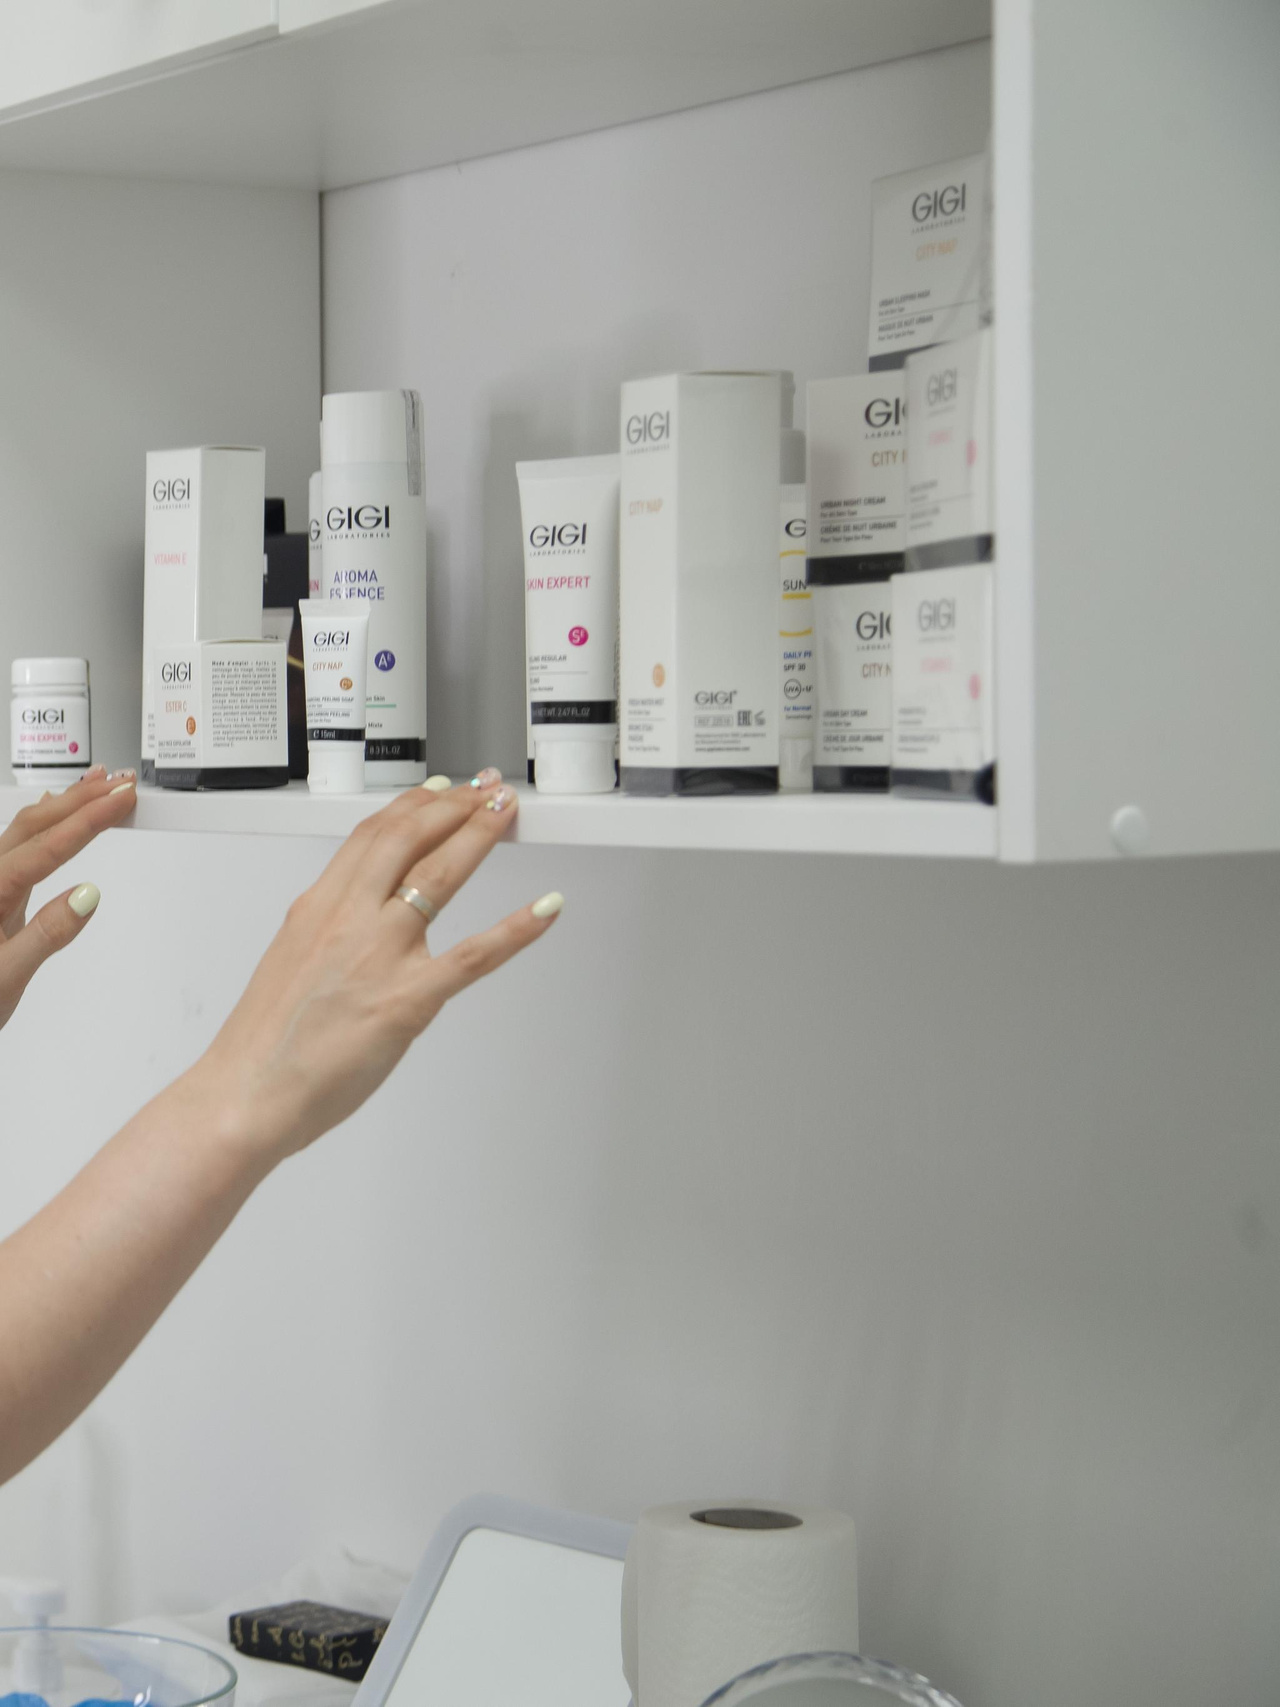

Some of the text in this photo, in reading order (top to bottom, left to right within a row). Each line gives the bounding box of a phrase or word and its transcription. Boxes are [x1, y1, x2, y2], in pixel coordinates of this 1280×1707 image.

[911, 182, 966, 223] GIGI
[927, 368, 958, 406] GIGI
[864, 397, 906, 428] GI
[626, 410, 670, 444] GIGI
[871, 450, 898, 468] CITY
[152, 478, 190, 502] GIGI
[326, 504, 390, 531] GIGI
[326, 532, 390, 540] LABORATORIES
[530, 522, 587, 548] GIGI
[154, 552, 180, 566] VITAMIN
[334, 569, 378, 584] AROMA
[526, 576, 590, 591] SKIN EXPERT
[783, 579, 807, 592] SUN
[919, 598, 956, 632] GIGI
[314, 630, 350, 646] GIGI
[784, 651, 802, 660] DAILY
[162, 662, 192, 684] GIGI
[312, 662, 344, 672] CITY NAP
[784, 663, 796, 672] SPF
[862, 663, 883, 678] CITY
[166, 700, 188, 713] ESTER C
[22, 708, 64, 724] GIGI
[37, 733, 67, 742] EXPERT
[320, 730, 336, 739] 15ml
